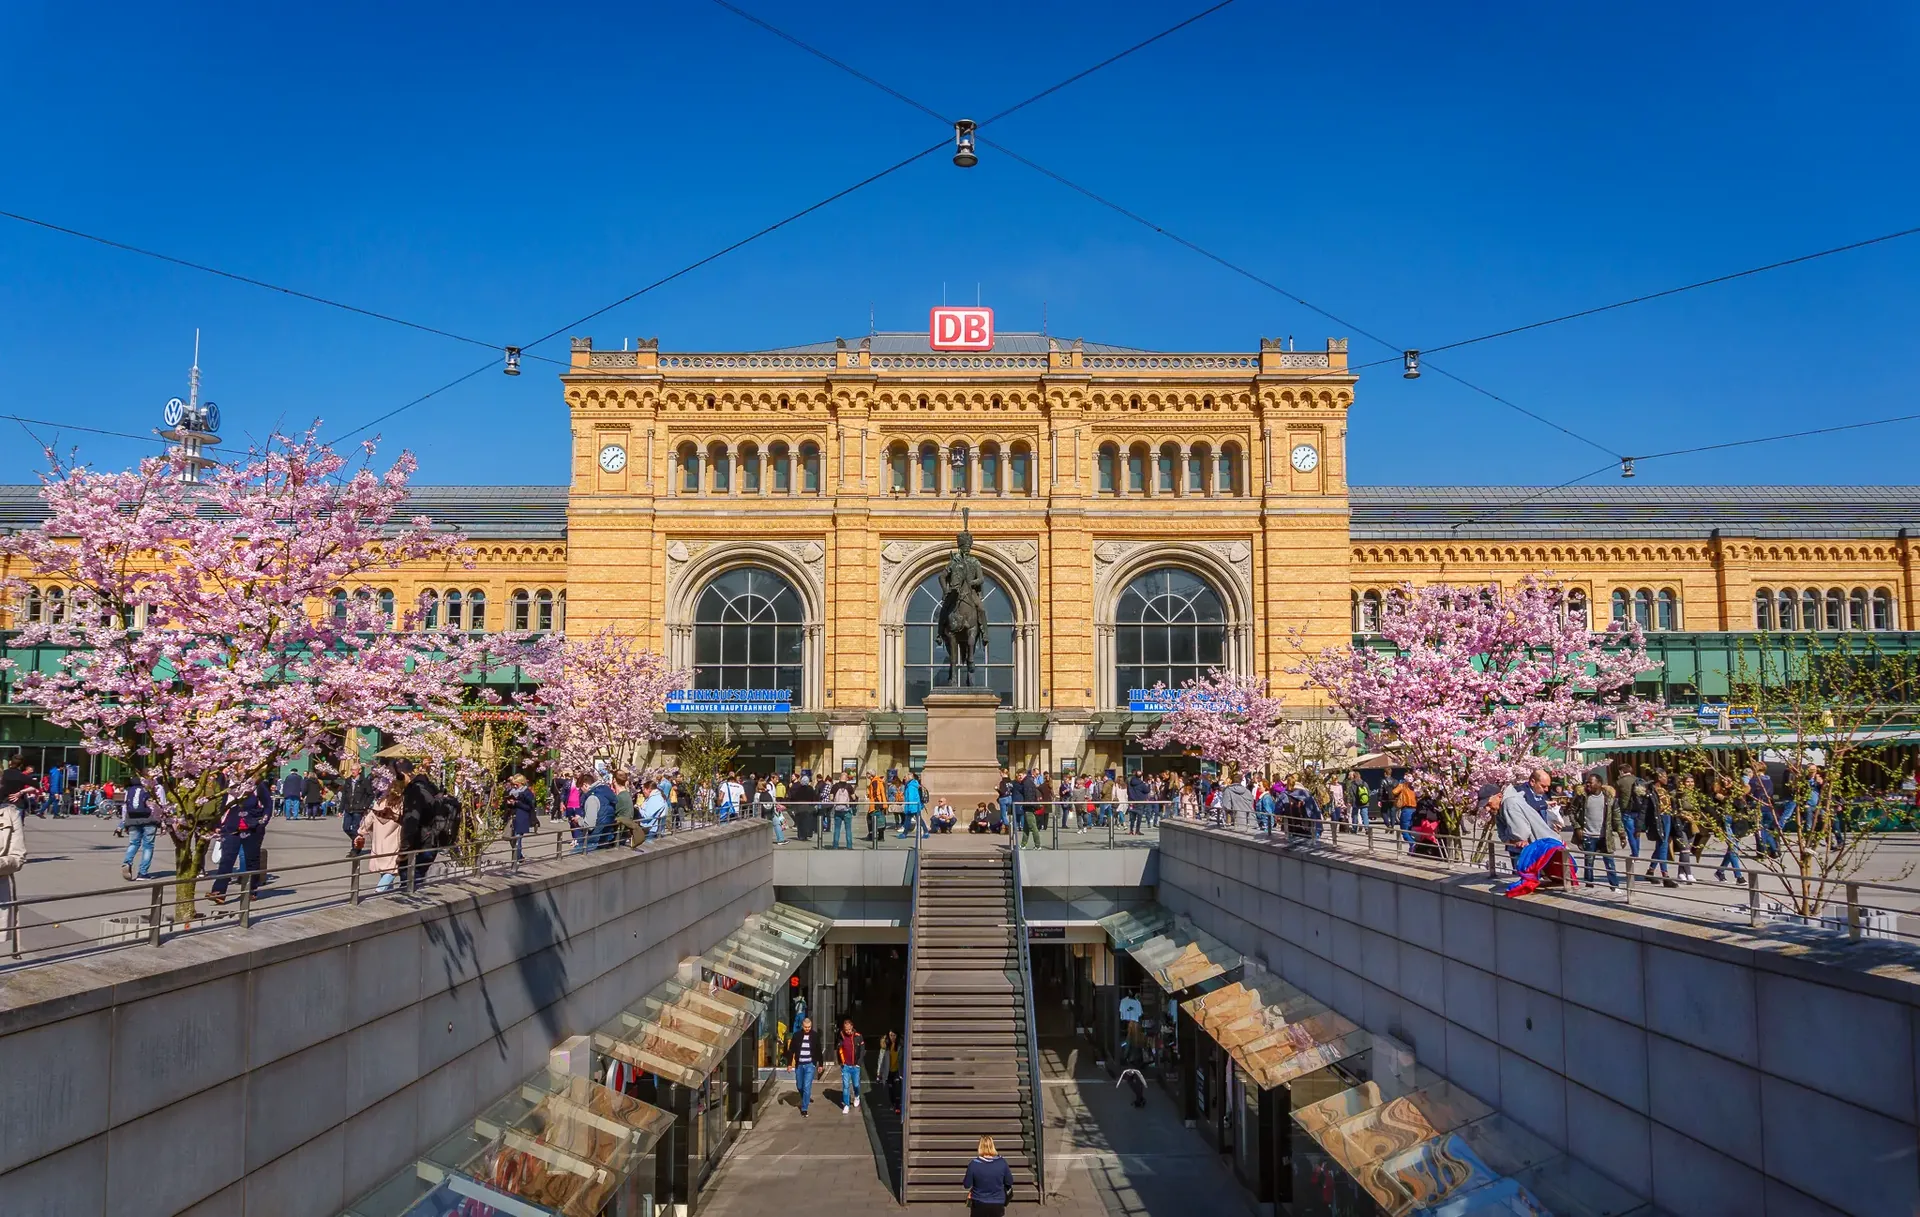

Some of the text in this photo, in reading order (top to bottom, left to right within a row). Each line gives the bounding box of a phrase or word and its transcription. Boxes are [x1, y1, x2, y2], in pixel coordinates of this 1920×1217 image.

[939, 314, 986, 342] DB
[165, 398, 183, 426] VW
[687, 689, 791, 700] EINKAUFSBAHNHOF
